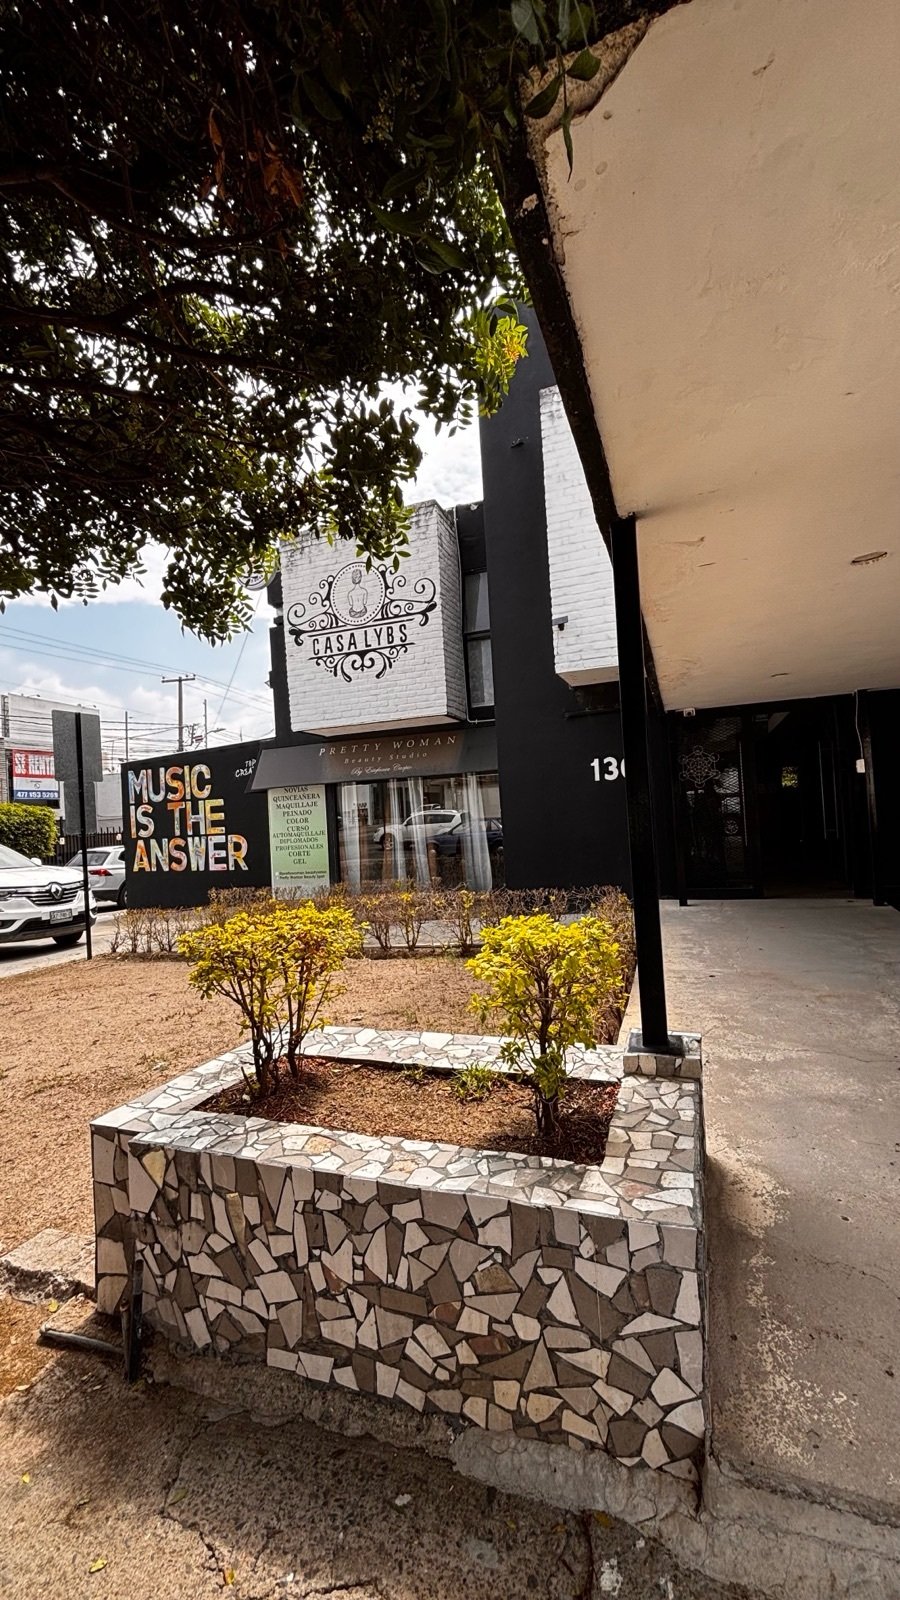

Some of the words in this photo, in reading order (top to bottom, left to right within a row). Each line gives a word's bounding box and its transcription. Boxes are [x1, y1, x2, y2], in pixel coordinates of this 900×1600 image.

[312, 632, 358, 656] CASA
[364, 623, 408, 648] LYBS
[319, 743, 382, 757] PRETTY
[393, 736, 457, 750] WOMAN
[389, 752, 428, 761] Studio
[14, 753, 27, 775] SE
[590, 756, 626, 781] 13
[128, 764, 212, 804] MUSIC
[273, 793, 321, 803] QUINCEAÑERA
[276, 801, 319, 810] MAQUILLAJE
[129, 804, 155, 839] IS
[167, 798, 226, 837] THE
[282, 809, 313, 817] PEINADO
[273, 830, 326, 838] AUTOMAQUILLAJE
[133, 834, 249, 872] ANSWER
[275, 843, 324, 851] PROFESIONALES
